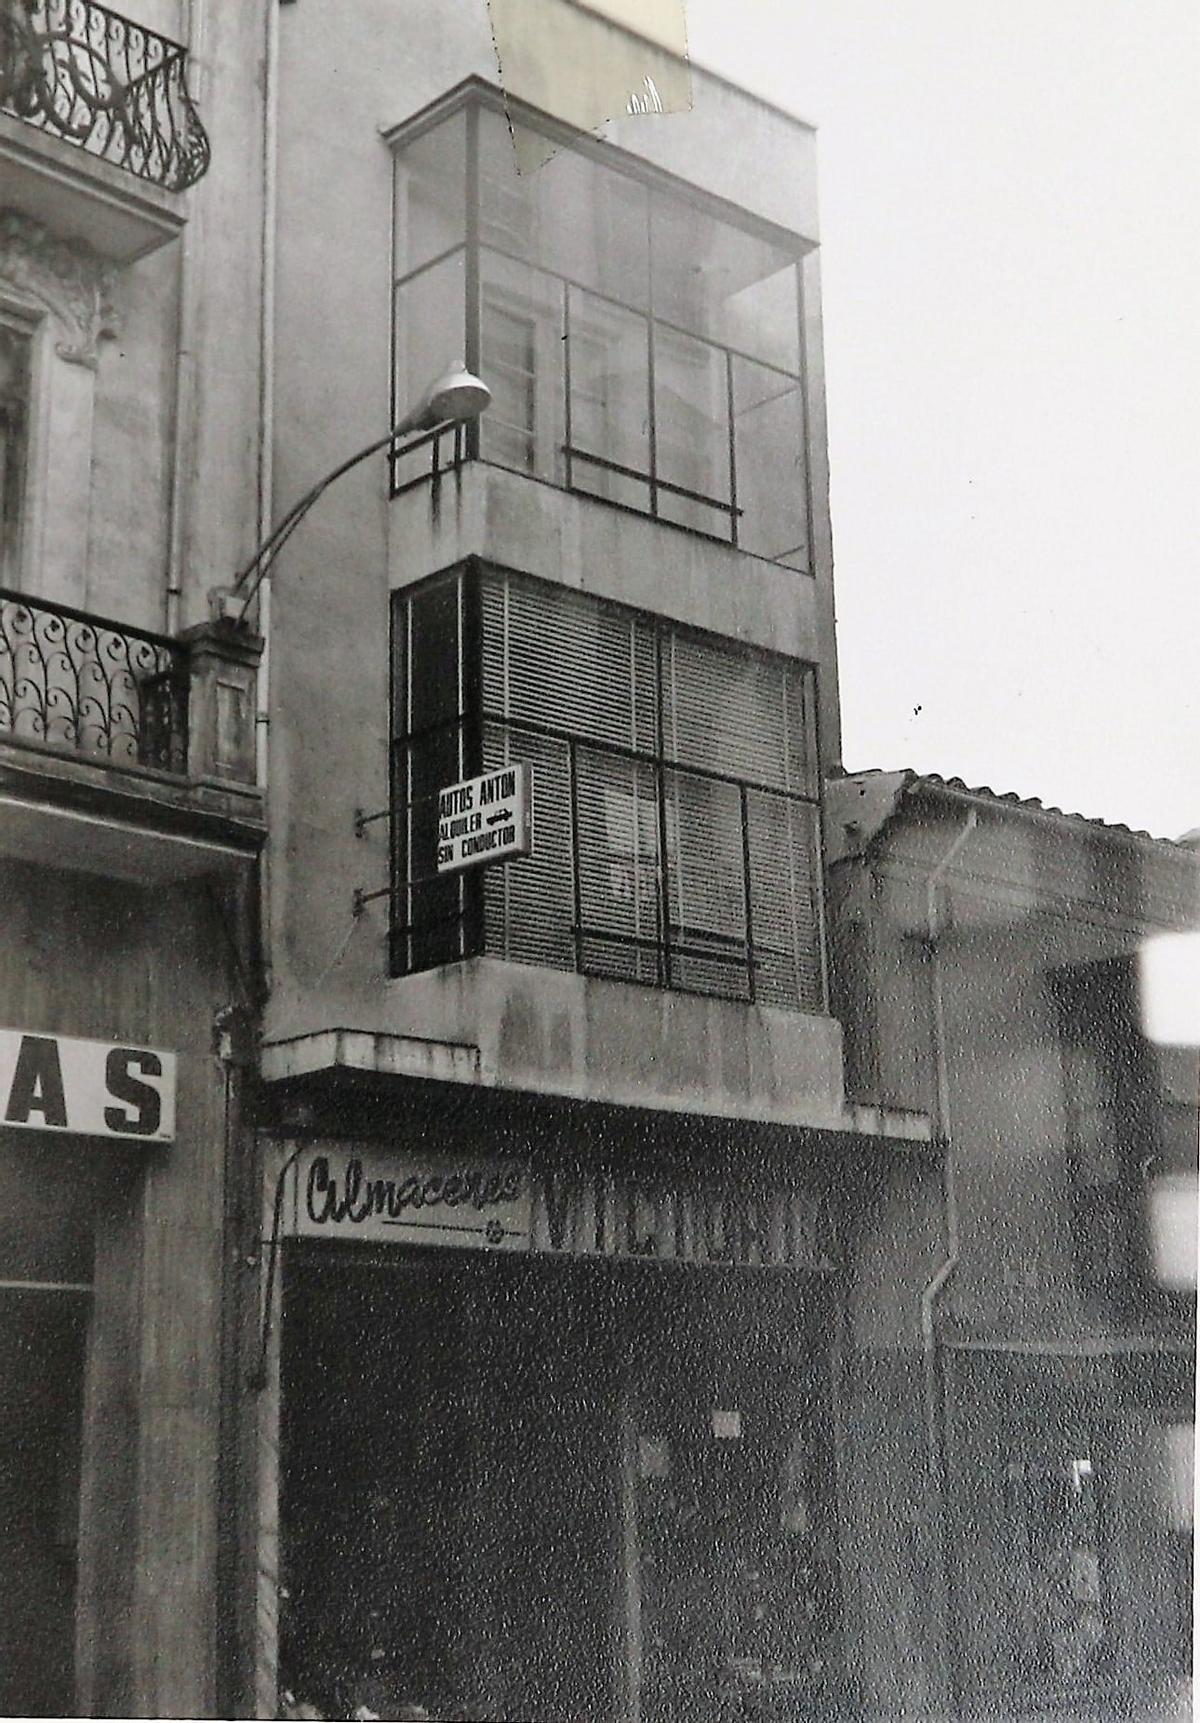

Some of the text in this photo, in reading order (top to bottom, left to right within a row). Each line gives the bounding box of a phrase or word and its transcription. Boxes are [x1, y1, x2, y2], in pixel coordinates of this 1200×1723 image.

[440, 770, 515, 819] AUTOS ANTON
[438, 825, 515, 865] SIN CONDUCTOR
